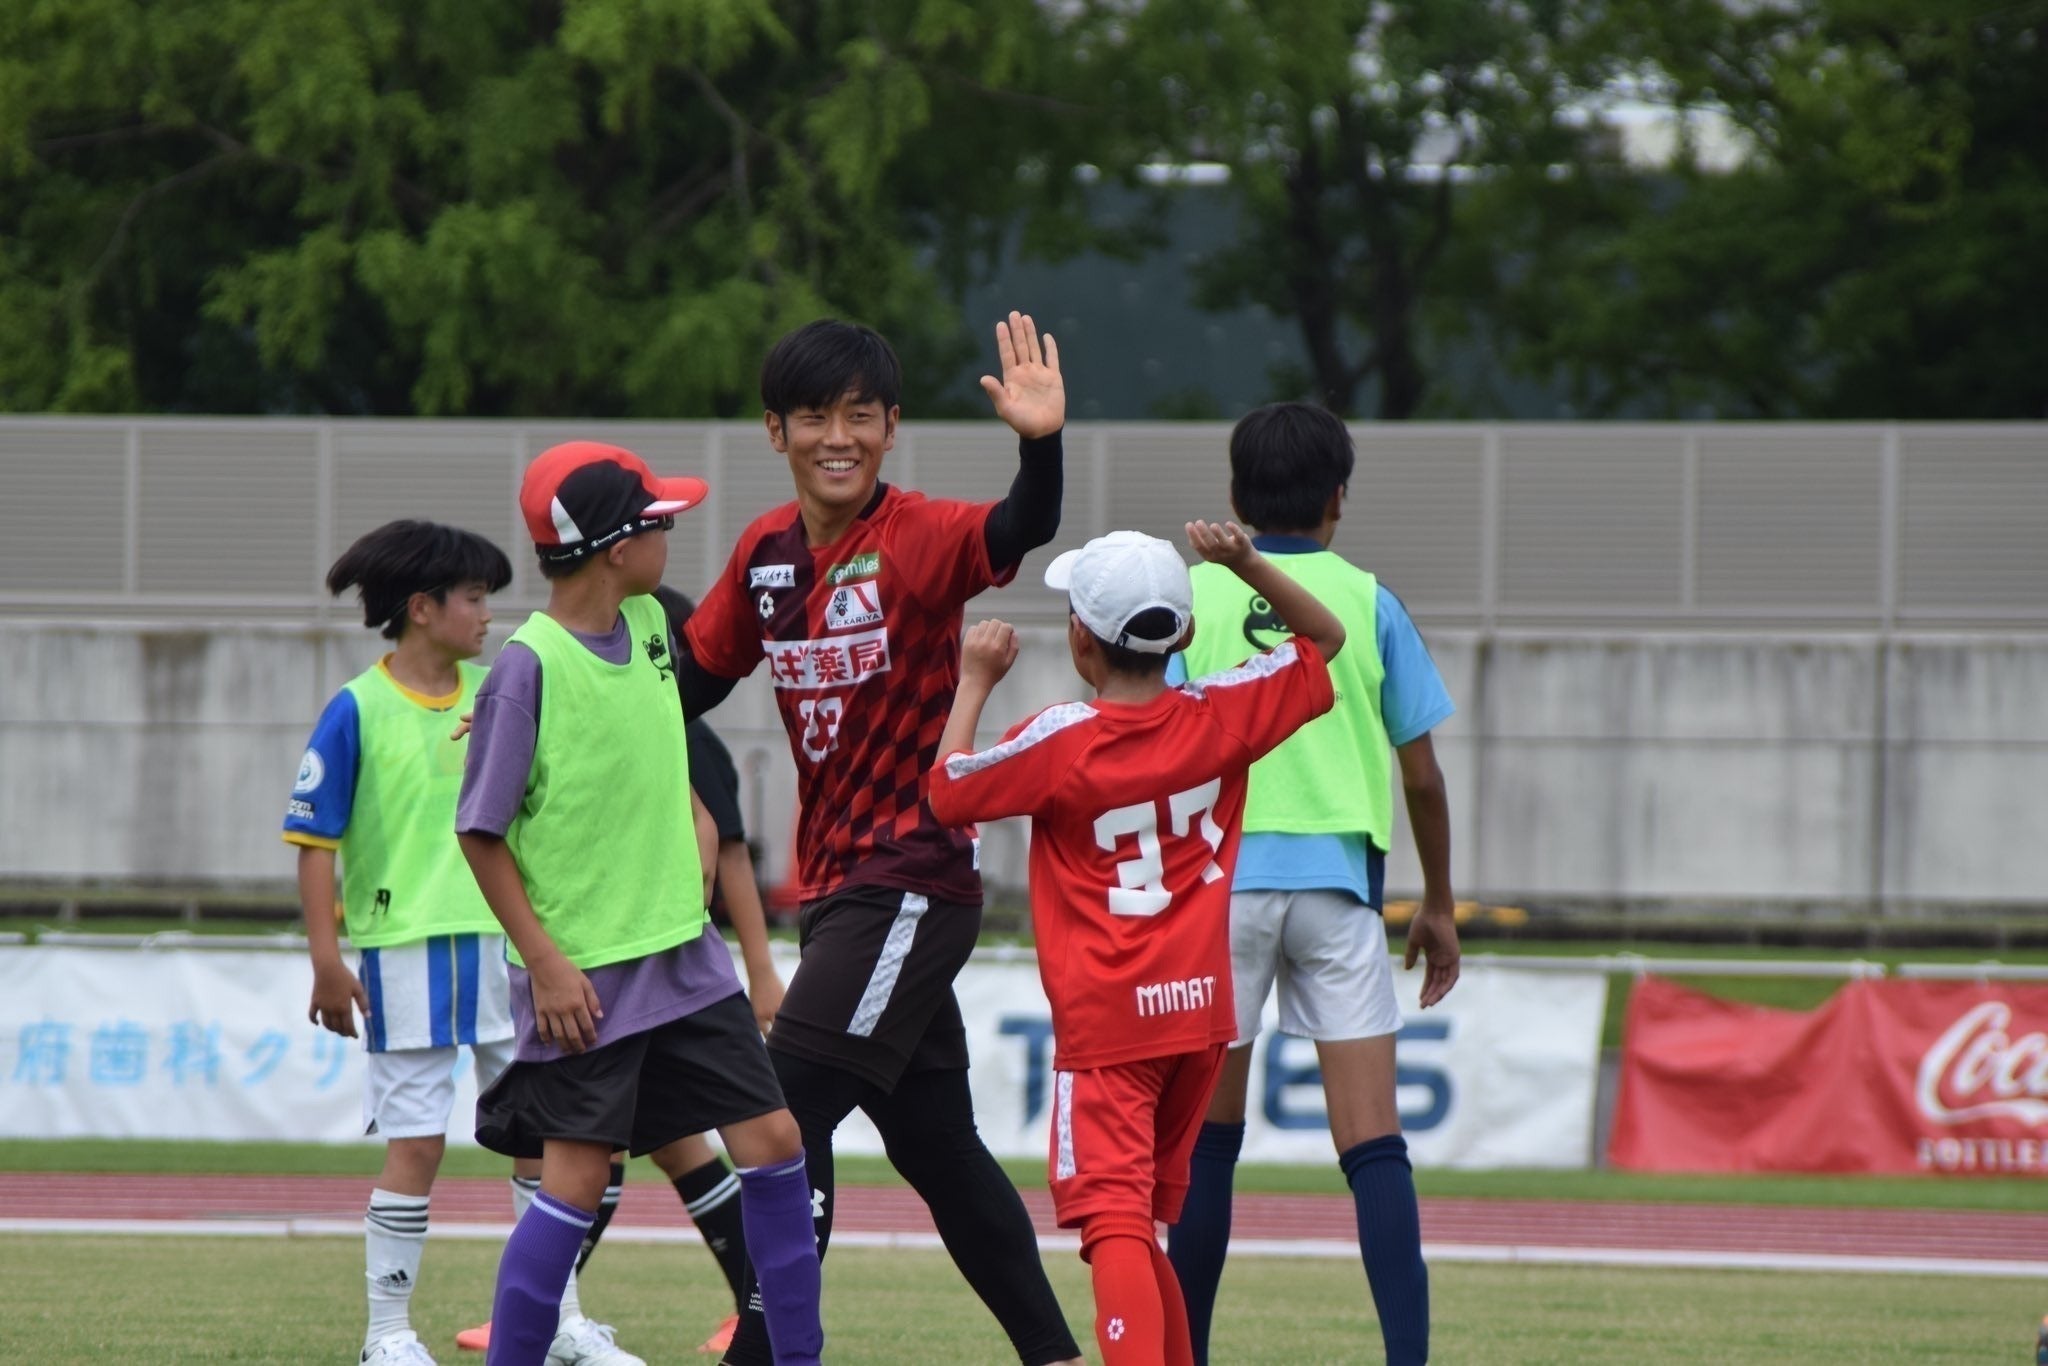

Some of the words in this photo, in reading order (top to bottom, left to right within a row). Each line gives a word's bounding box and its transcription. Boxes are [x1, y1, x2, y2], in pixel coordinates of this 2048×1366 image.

[829, 620, 842, 628] FC
[843, 613, 881, 626] KARIYA
[1093, 777, 1226, 917] 37
[1136, 976, 1217, 1017] MINAT
